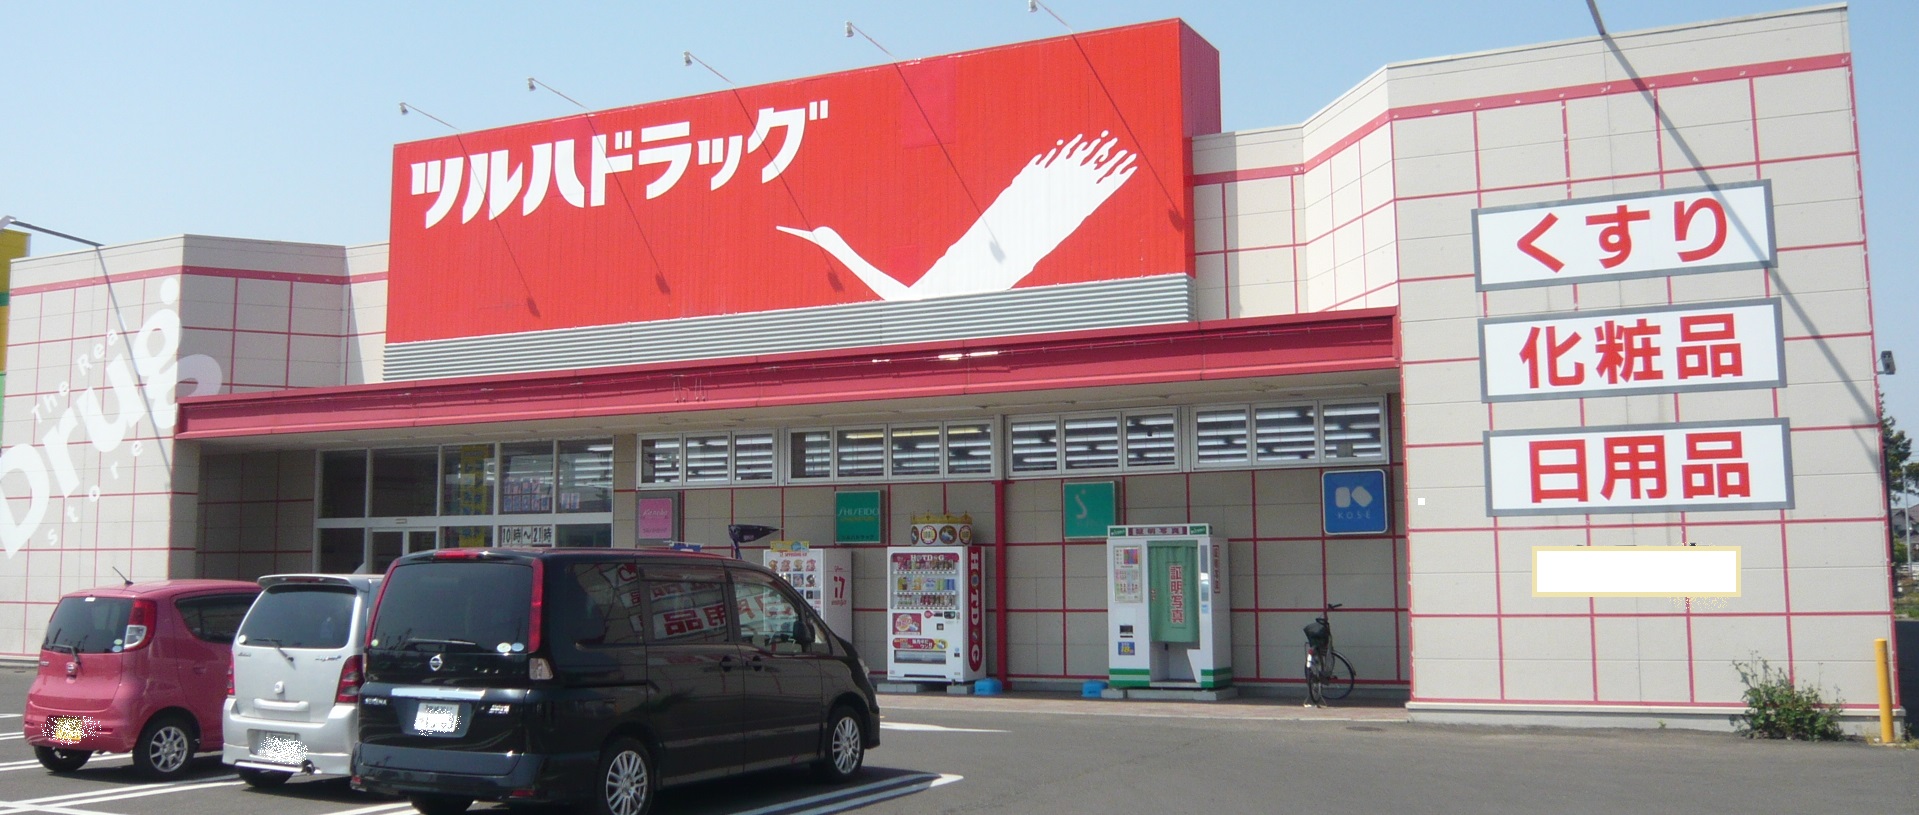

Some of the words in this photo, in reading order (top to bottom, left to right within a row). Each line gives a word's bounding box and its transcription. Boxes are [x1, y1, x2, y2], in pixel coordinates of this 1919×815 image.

[411, 99, 829, 229] ツルハドラッグ
[1516, 197, 1728, 274] くすり
[1519, 313, 1743, 389] 化粧品
[1528, 431, 1750, 504] 日用品
[1169, 565, 1185, 624] 証明写真
